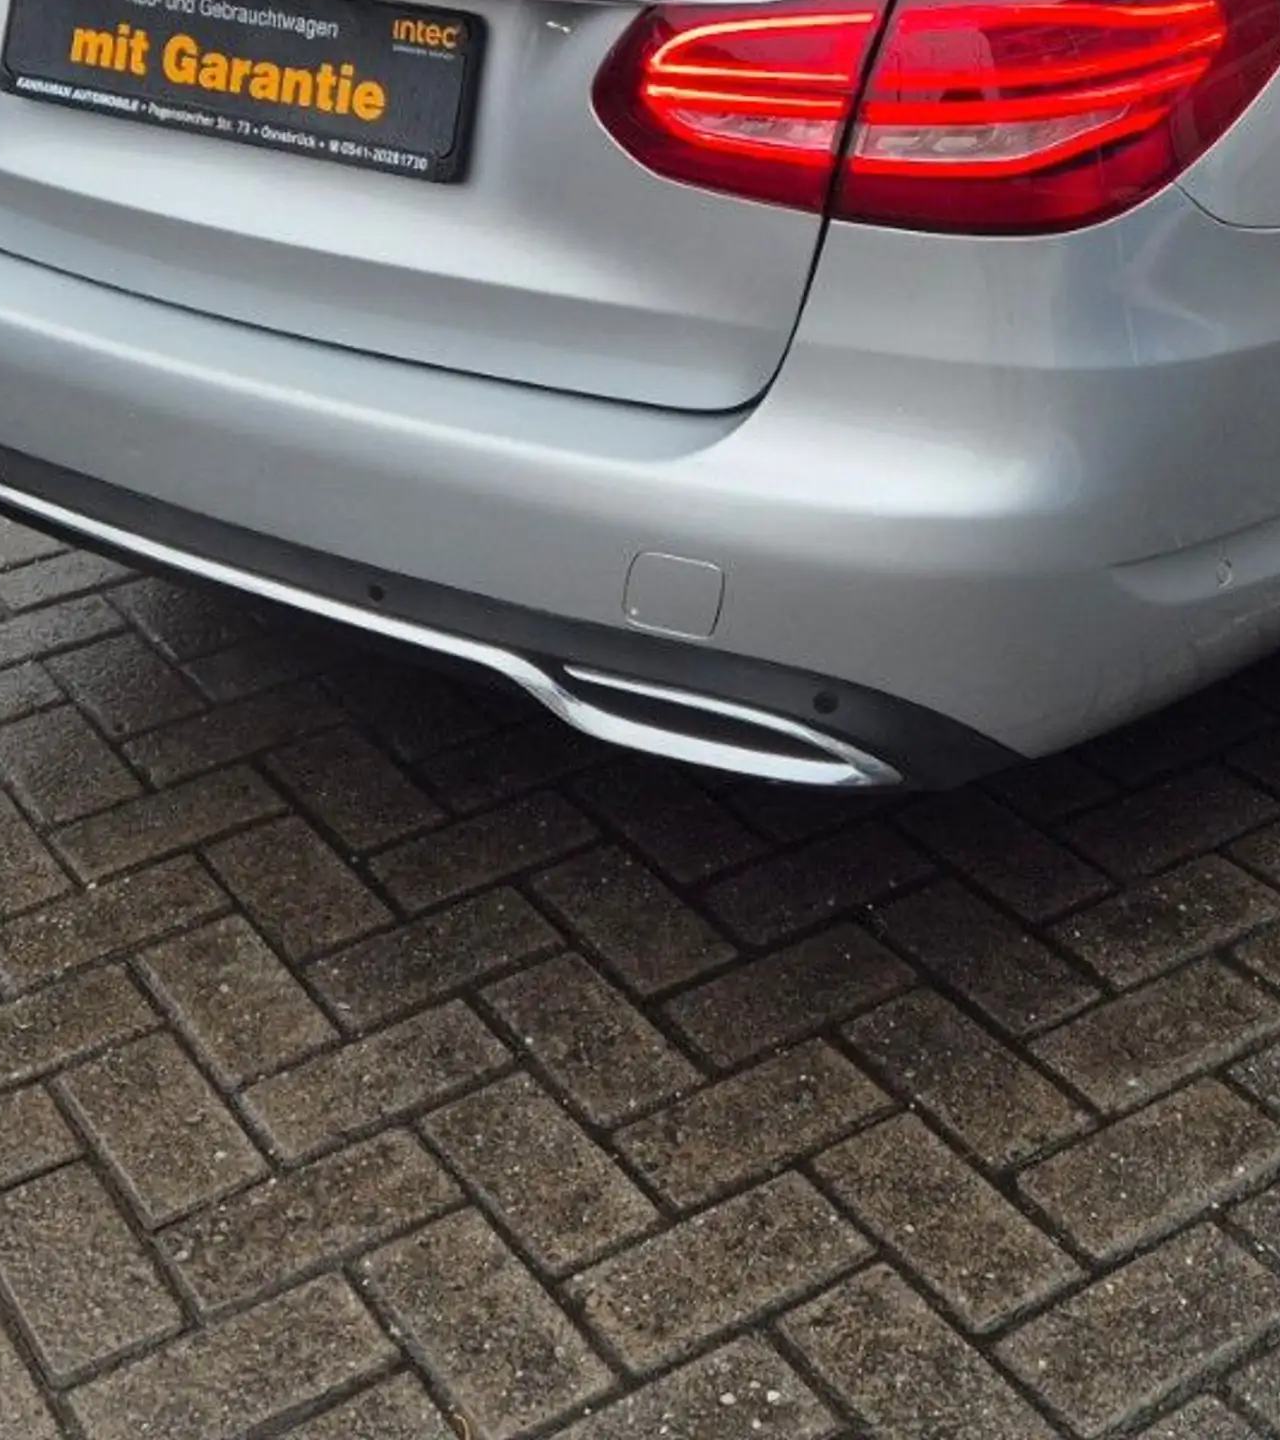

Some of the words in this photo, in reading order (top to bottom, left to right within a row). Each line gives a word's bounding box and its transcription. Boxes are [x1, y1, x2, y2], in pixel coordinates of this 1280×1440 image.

[391, 18, 457, 50] intec
[70, 23, 150, 77] mit
[162, 33, 386, 121] Garantie
